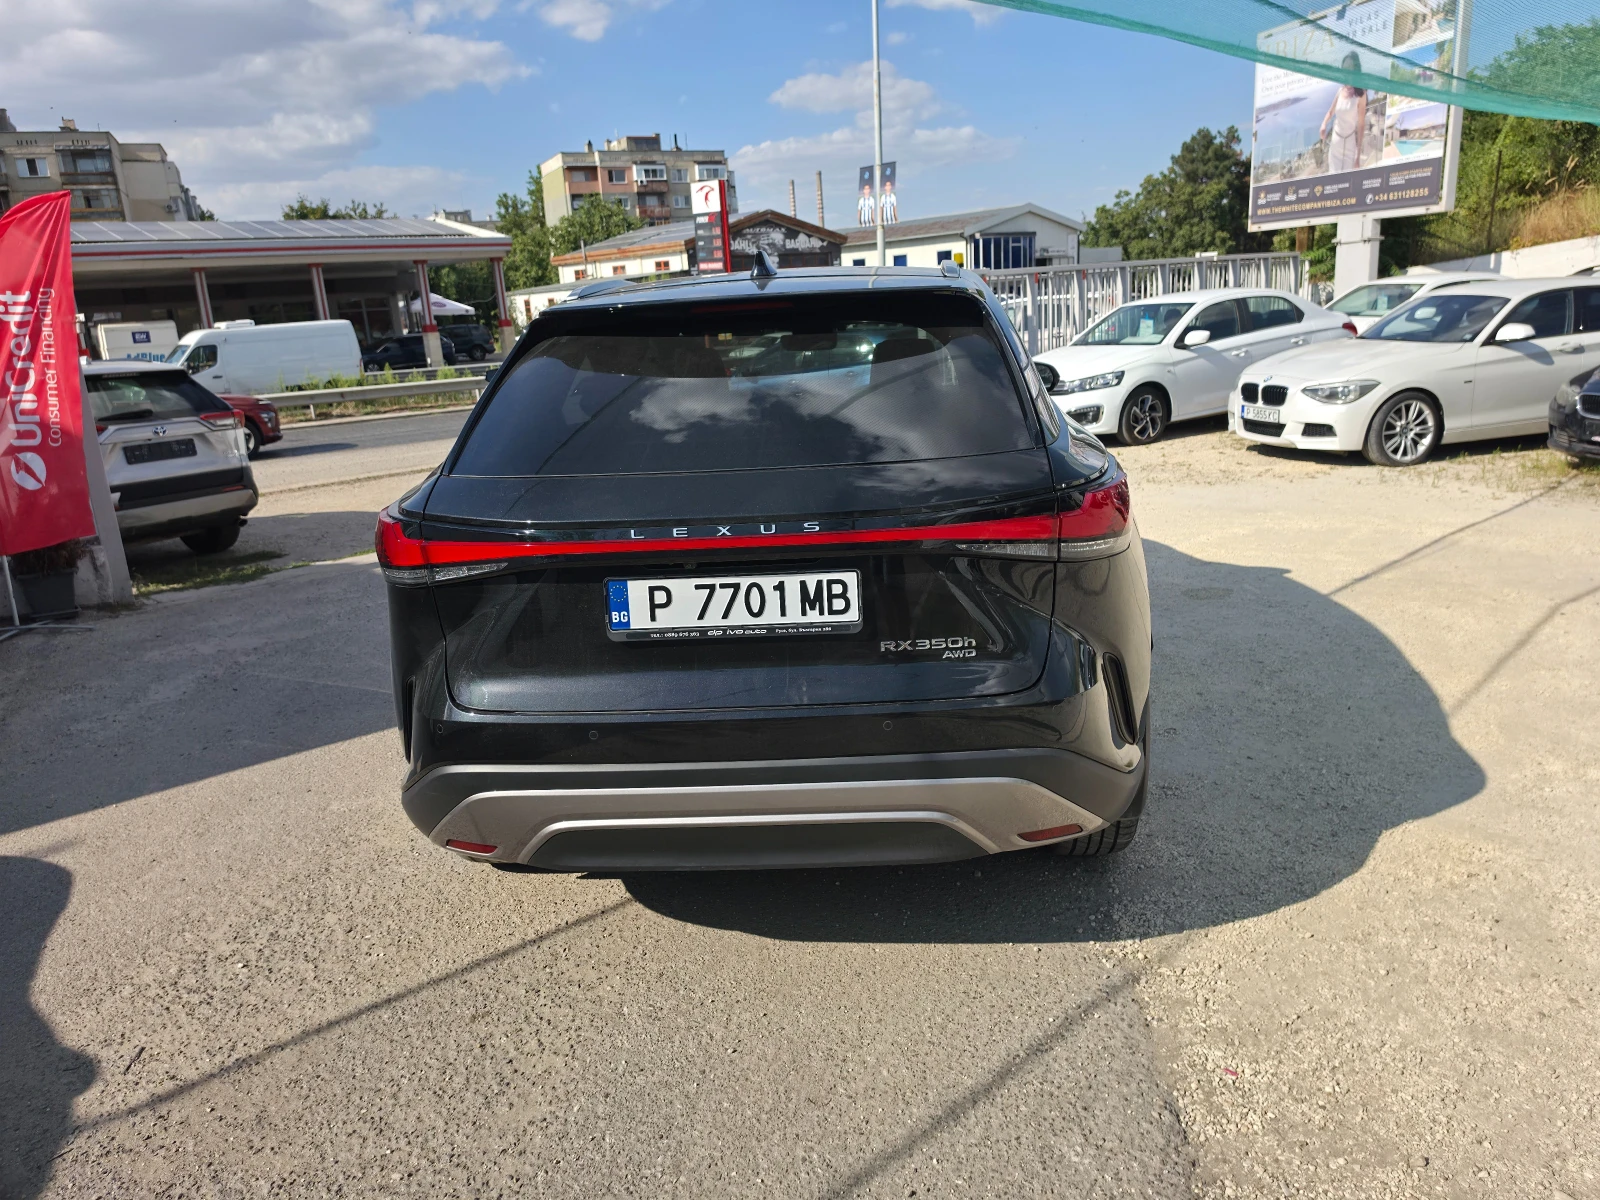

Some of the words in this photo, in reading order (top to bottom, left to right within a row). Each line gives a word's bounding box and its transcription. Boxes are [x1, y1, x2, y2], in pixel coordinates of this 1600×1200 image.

[38, 287, 56, 364] Financing
[0, 290, 42, 447] UniCredit
[46, 368, 62, 447] Consumer
[630, 521, 820, 539] LEXUS
[612, 610, 629, 623] BG
[648, 585, 673, 622] P
[694, 580, 787, 620] 7701
[799, 578, 851, 617] MB
[942, 648, 977, 659] AWD
